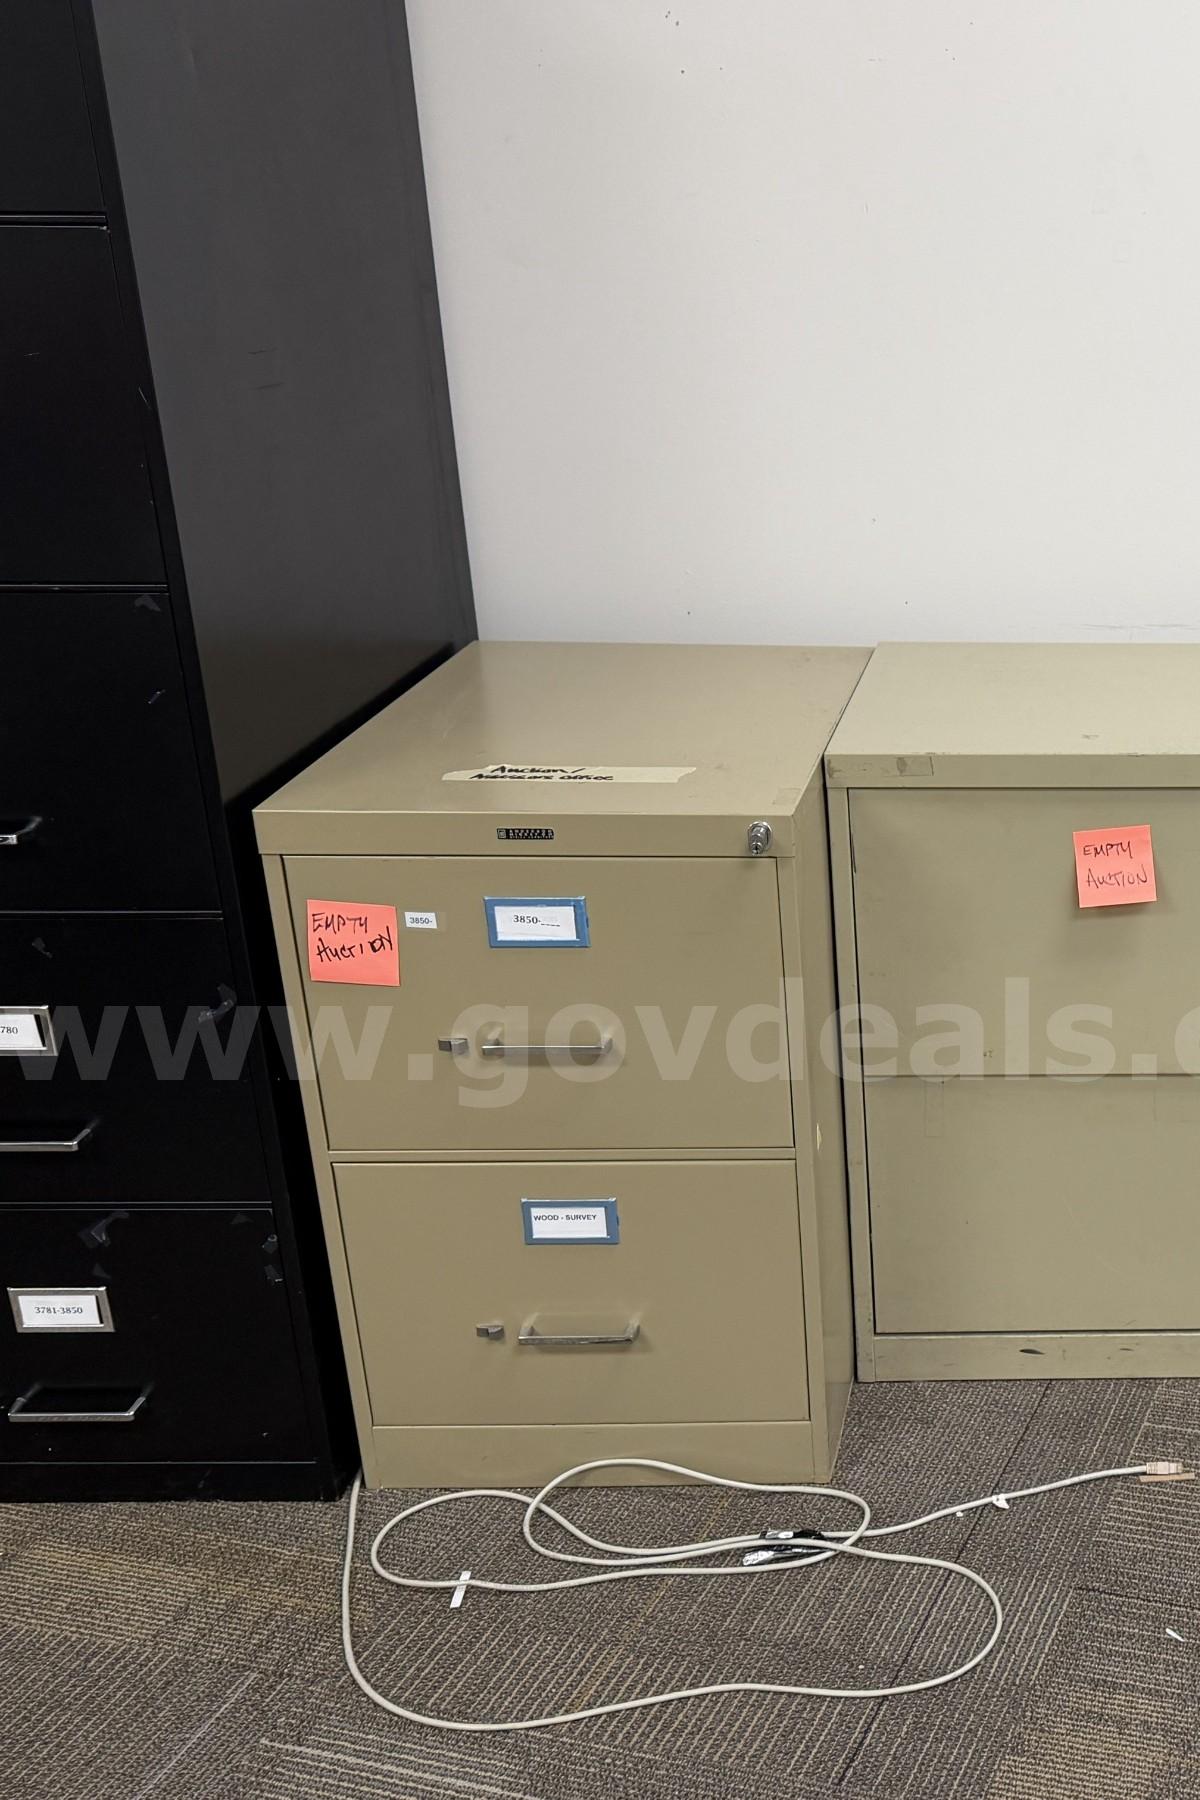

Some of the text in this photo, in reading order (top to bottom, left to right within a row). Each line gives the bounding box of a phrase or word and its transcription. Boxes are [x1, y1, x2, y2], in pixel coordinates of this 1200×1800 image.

[1083, 840, 1133, 860] EMPTY
[1086, 864, 1148, 889] AUCTION
[312, 912, 368, 935] EMPTY
[34, 1306, 83, 1314] 3781-3850
